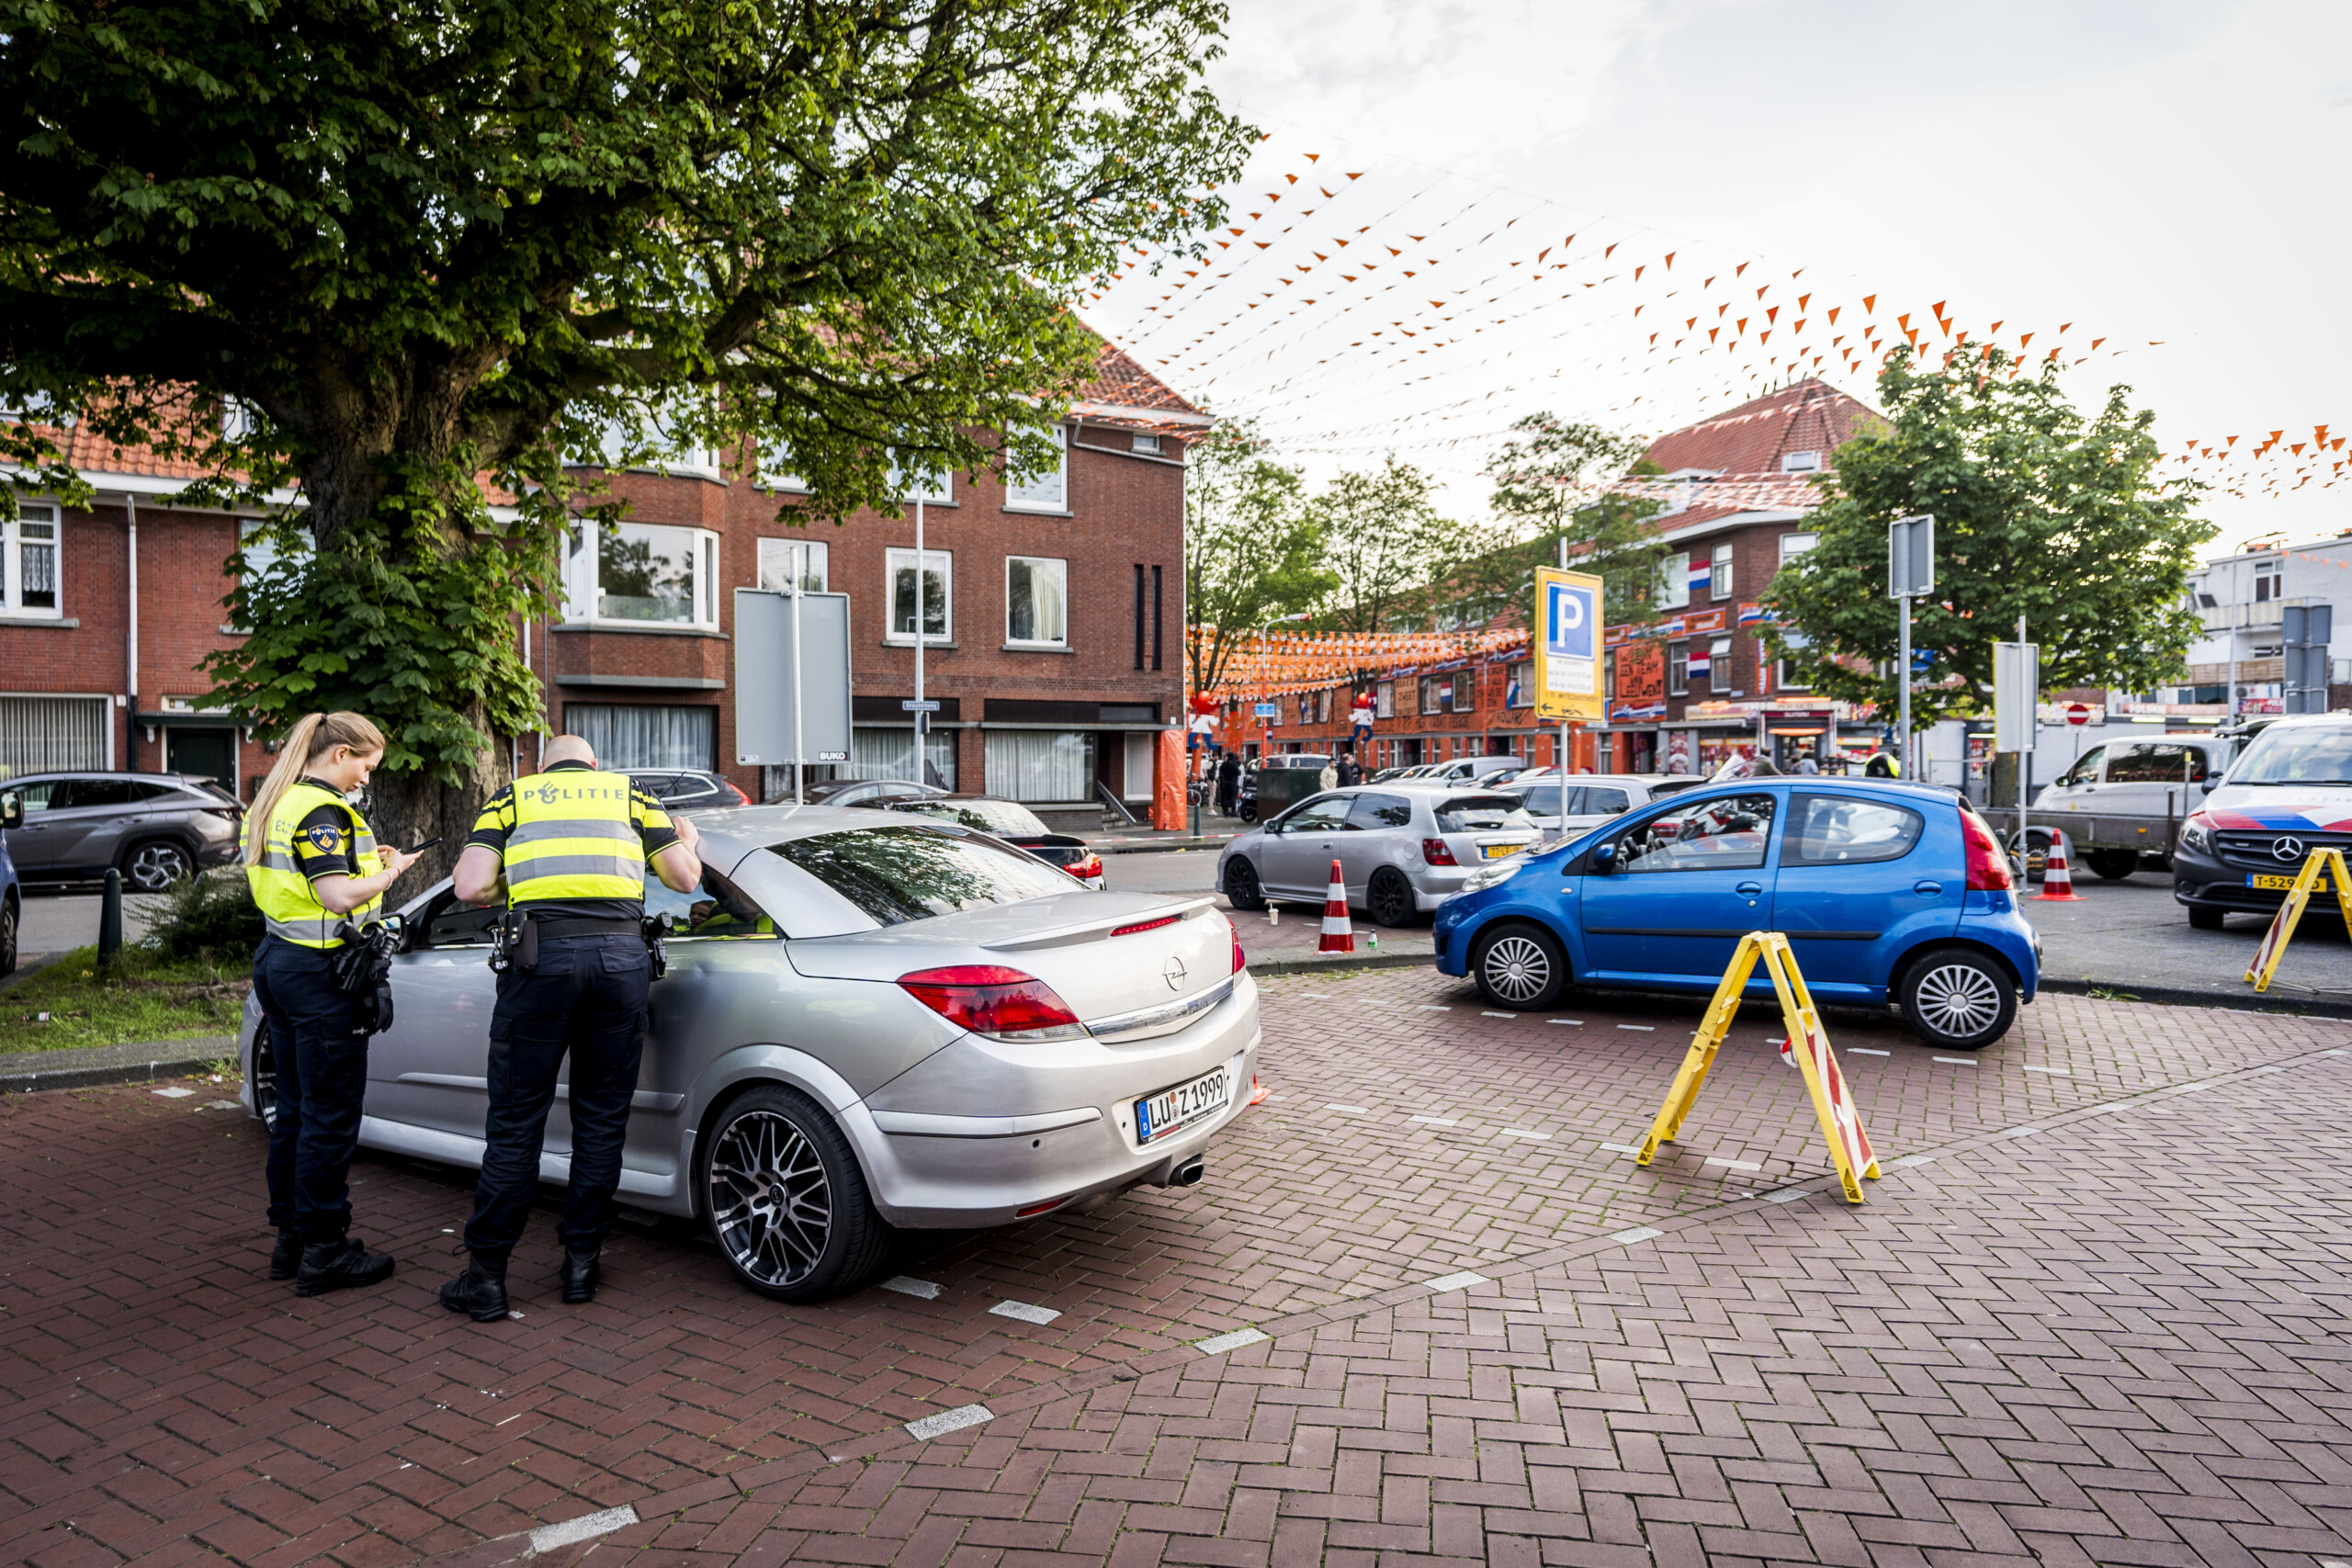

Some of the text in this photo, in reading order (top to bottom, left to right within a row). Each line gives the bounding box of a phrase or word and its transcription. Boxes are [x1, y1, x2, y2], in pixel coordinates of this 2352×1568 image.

[1557, 592, 1584, 648] P
[820, 751, 845, 761] BUKO
[524, 781, 625, 805] POLITIE
[1148, 1096, 1171, 1130] LU
